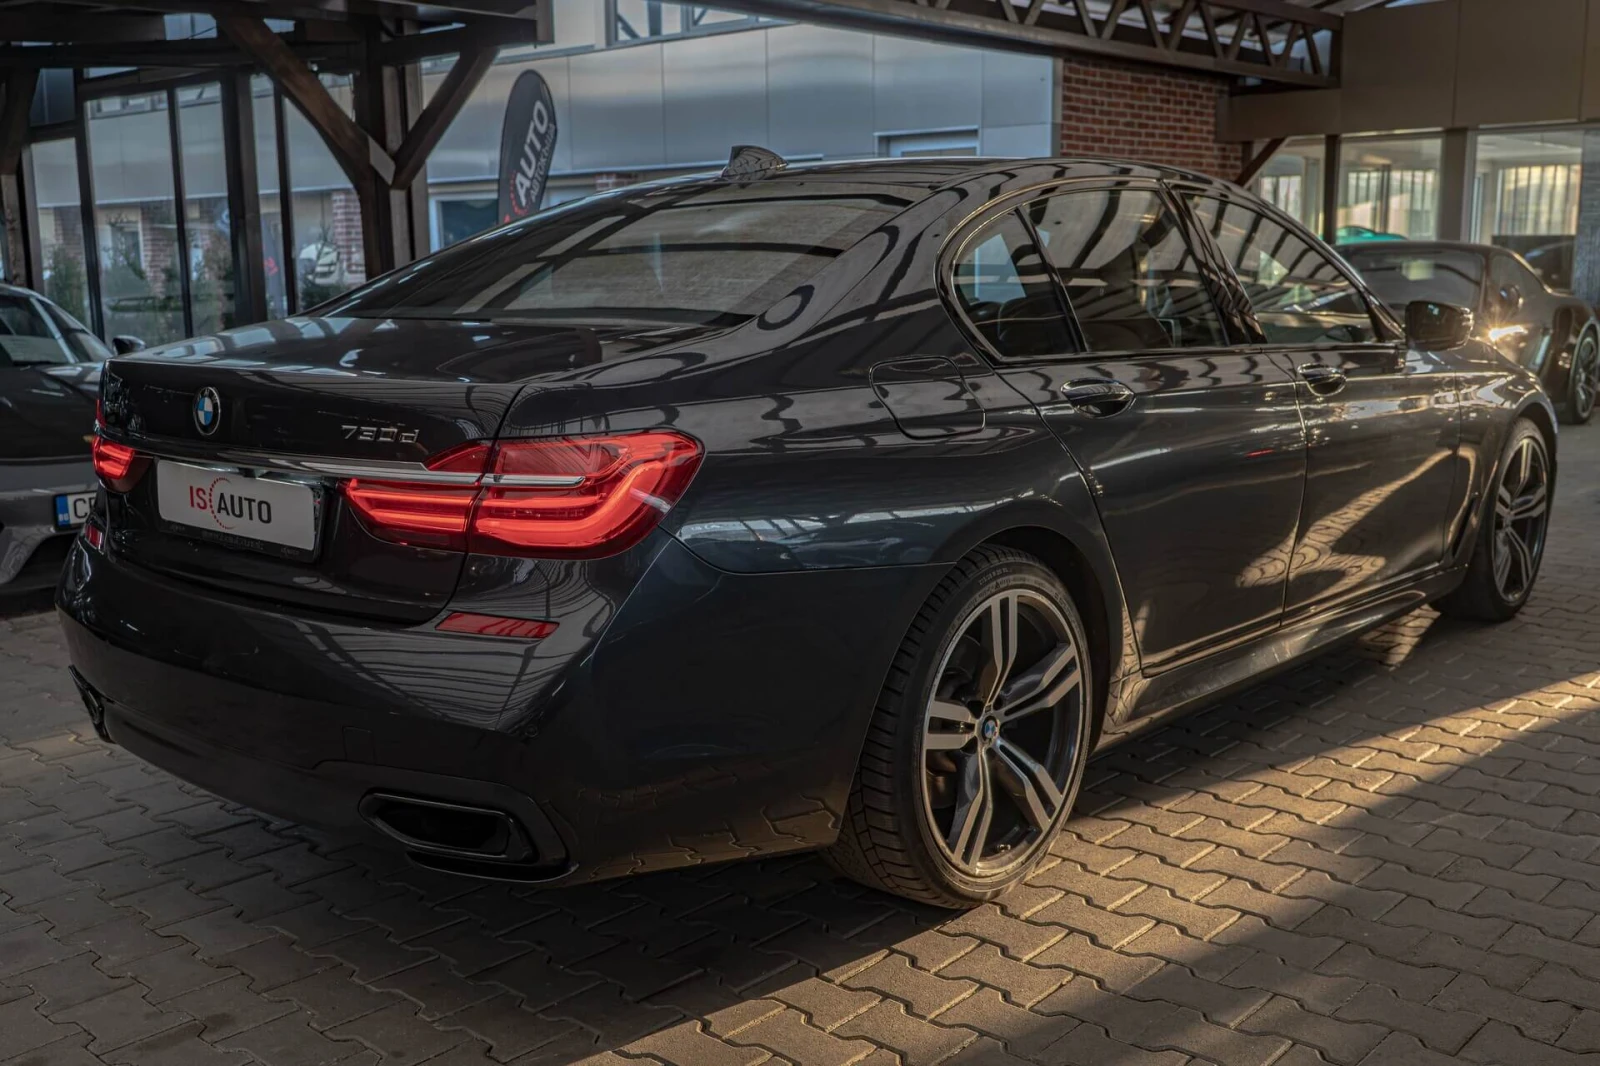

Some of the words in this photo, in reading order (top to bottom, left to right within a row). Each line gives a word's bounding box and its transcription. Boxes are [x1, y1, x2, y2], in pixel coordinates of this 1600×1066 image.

[515, 100, 549, 207] AUTO
[341, 425, 420, 444] 730d
[189, 485, 208, 510] IS
[217, 492, 272, 524] AUTO
